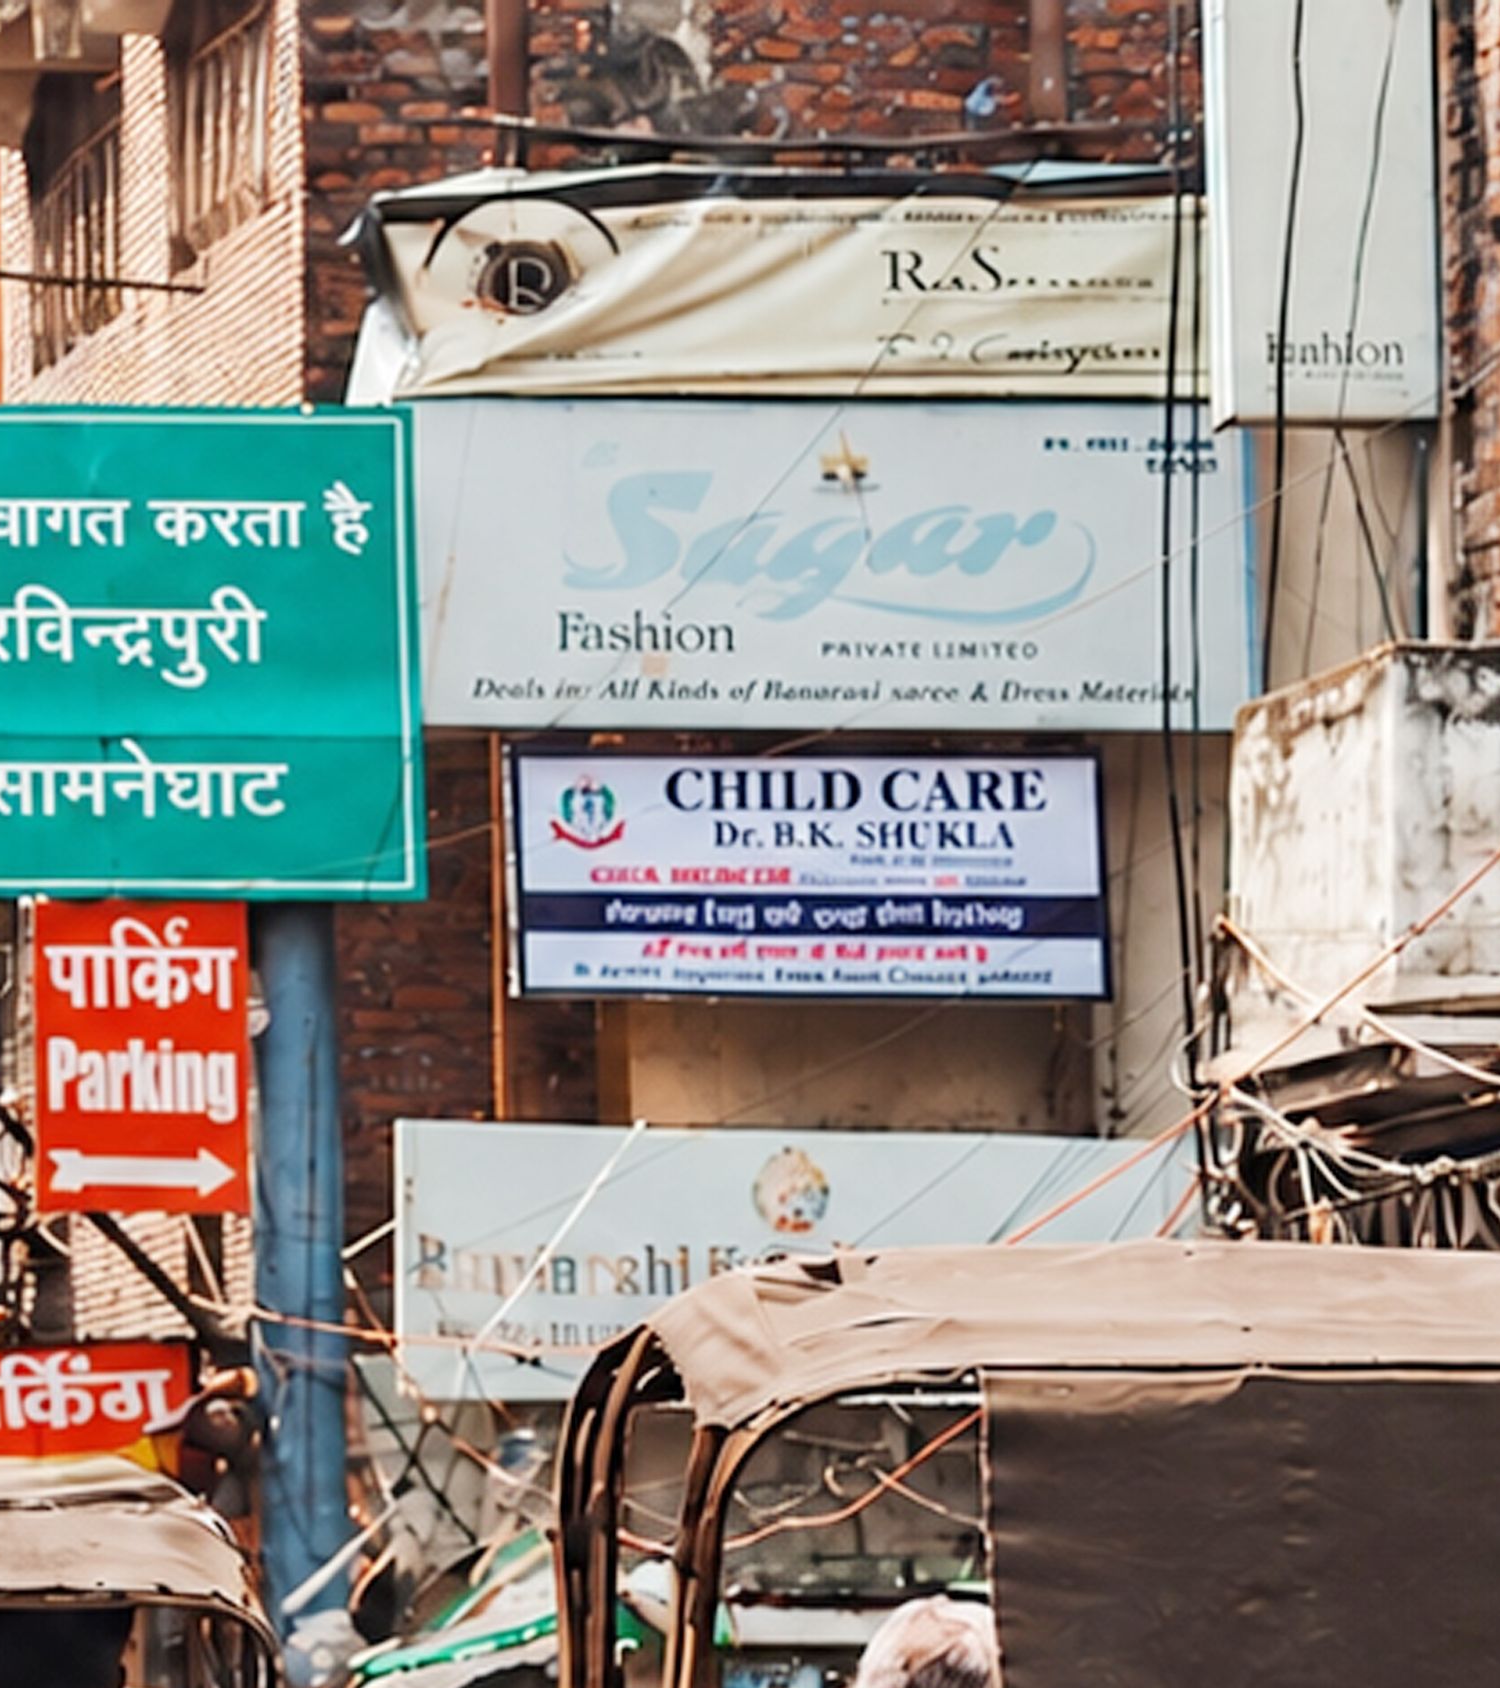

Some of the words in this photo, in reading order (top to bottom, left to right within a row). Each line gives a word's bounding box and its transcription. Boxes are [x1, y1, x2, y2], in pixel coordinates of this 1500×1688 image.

[147, 499, 307, 547] करता
[323, 480, 372, 556] है
[562, 470, 1097, 624] Sagar
[557, 610, 736, 654] Fashion
[820, 641, 922, 660] PRIVATE
[931, 641, 1039, 660] LIMITED
[473, 677, 545, 699] Deals
[599, 677, 640, 700] All
[647, 677, 720, 701] Kinds
[728, 678, 758, 704] of
[1000, 680, 1070, 702] Dress
[664, 768, 862, 813] CHILD
[880, 768, 1047, 813] CARE
[714, 820, 763, 850] Dr.
[773, 820, 844, 850] B.K.
[856, 820, 1016, 850] SHUKLA
[47, 1036, 239, 1125] Parking
